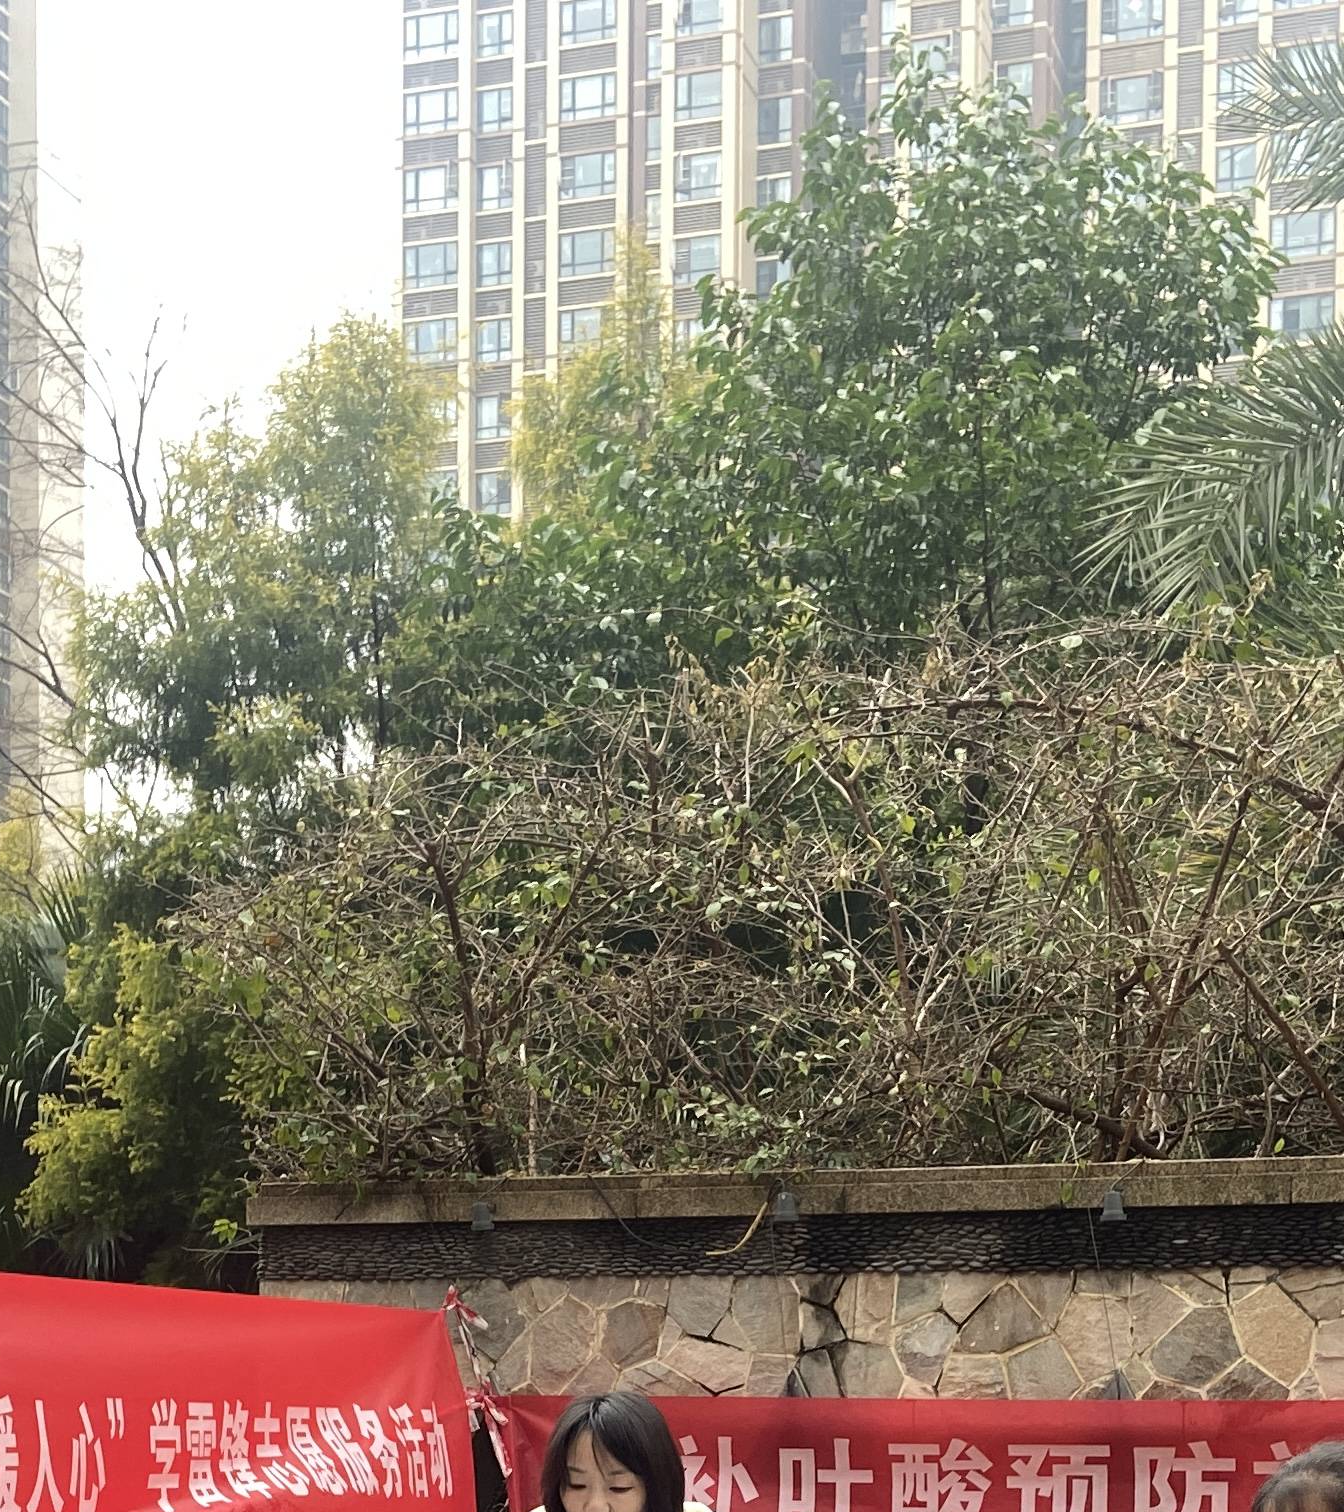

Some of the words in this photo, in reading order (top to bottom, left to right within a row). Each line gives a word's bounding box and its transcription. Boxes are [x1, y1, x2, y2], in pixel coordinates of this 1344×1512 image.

[147, 1398, 454, 1512] 学雷锋志愿服务活动
